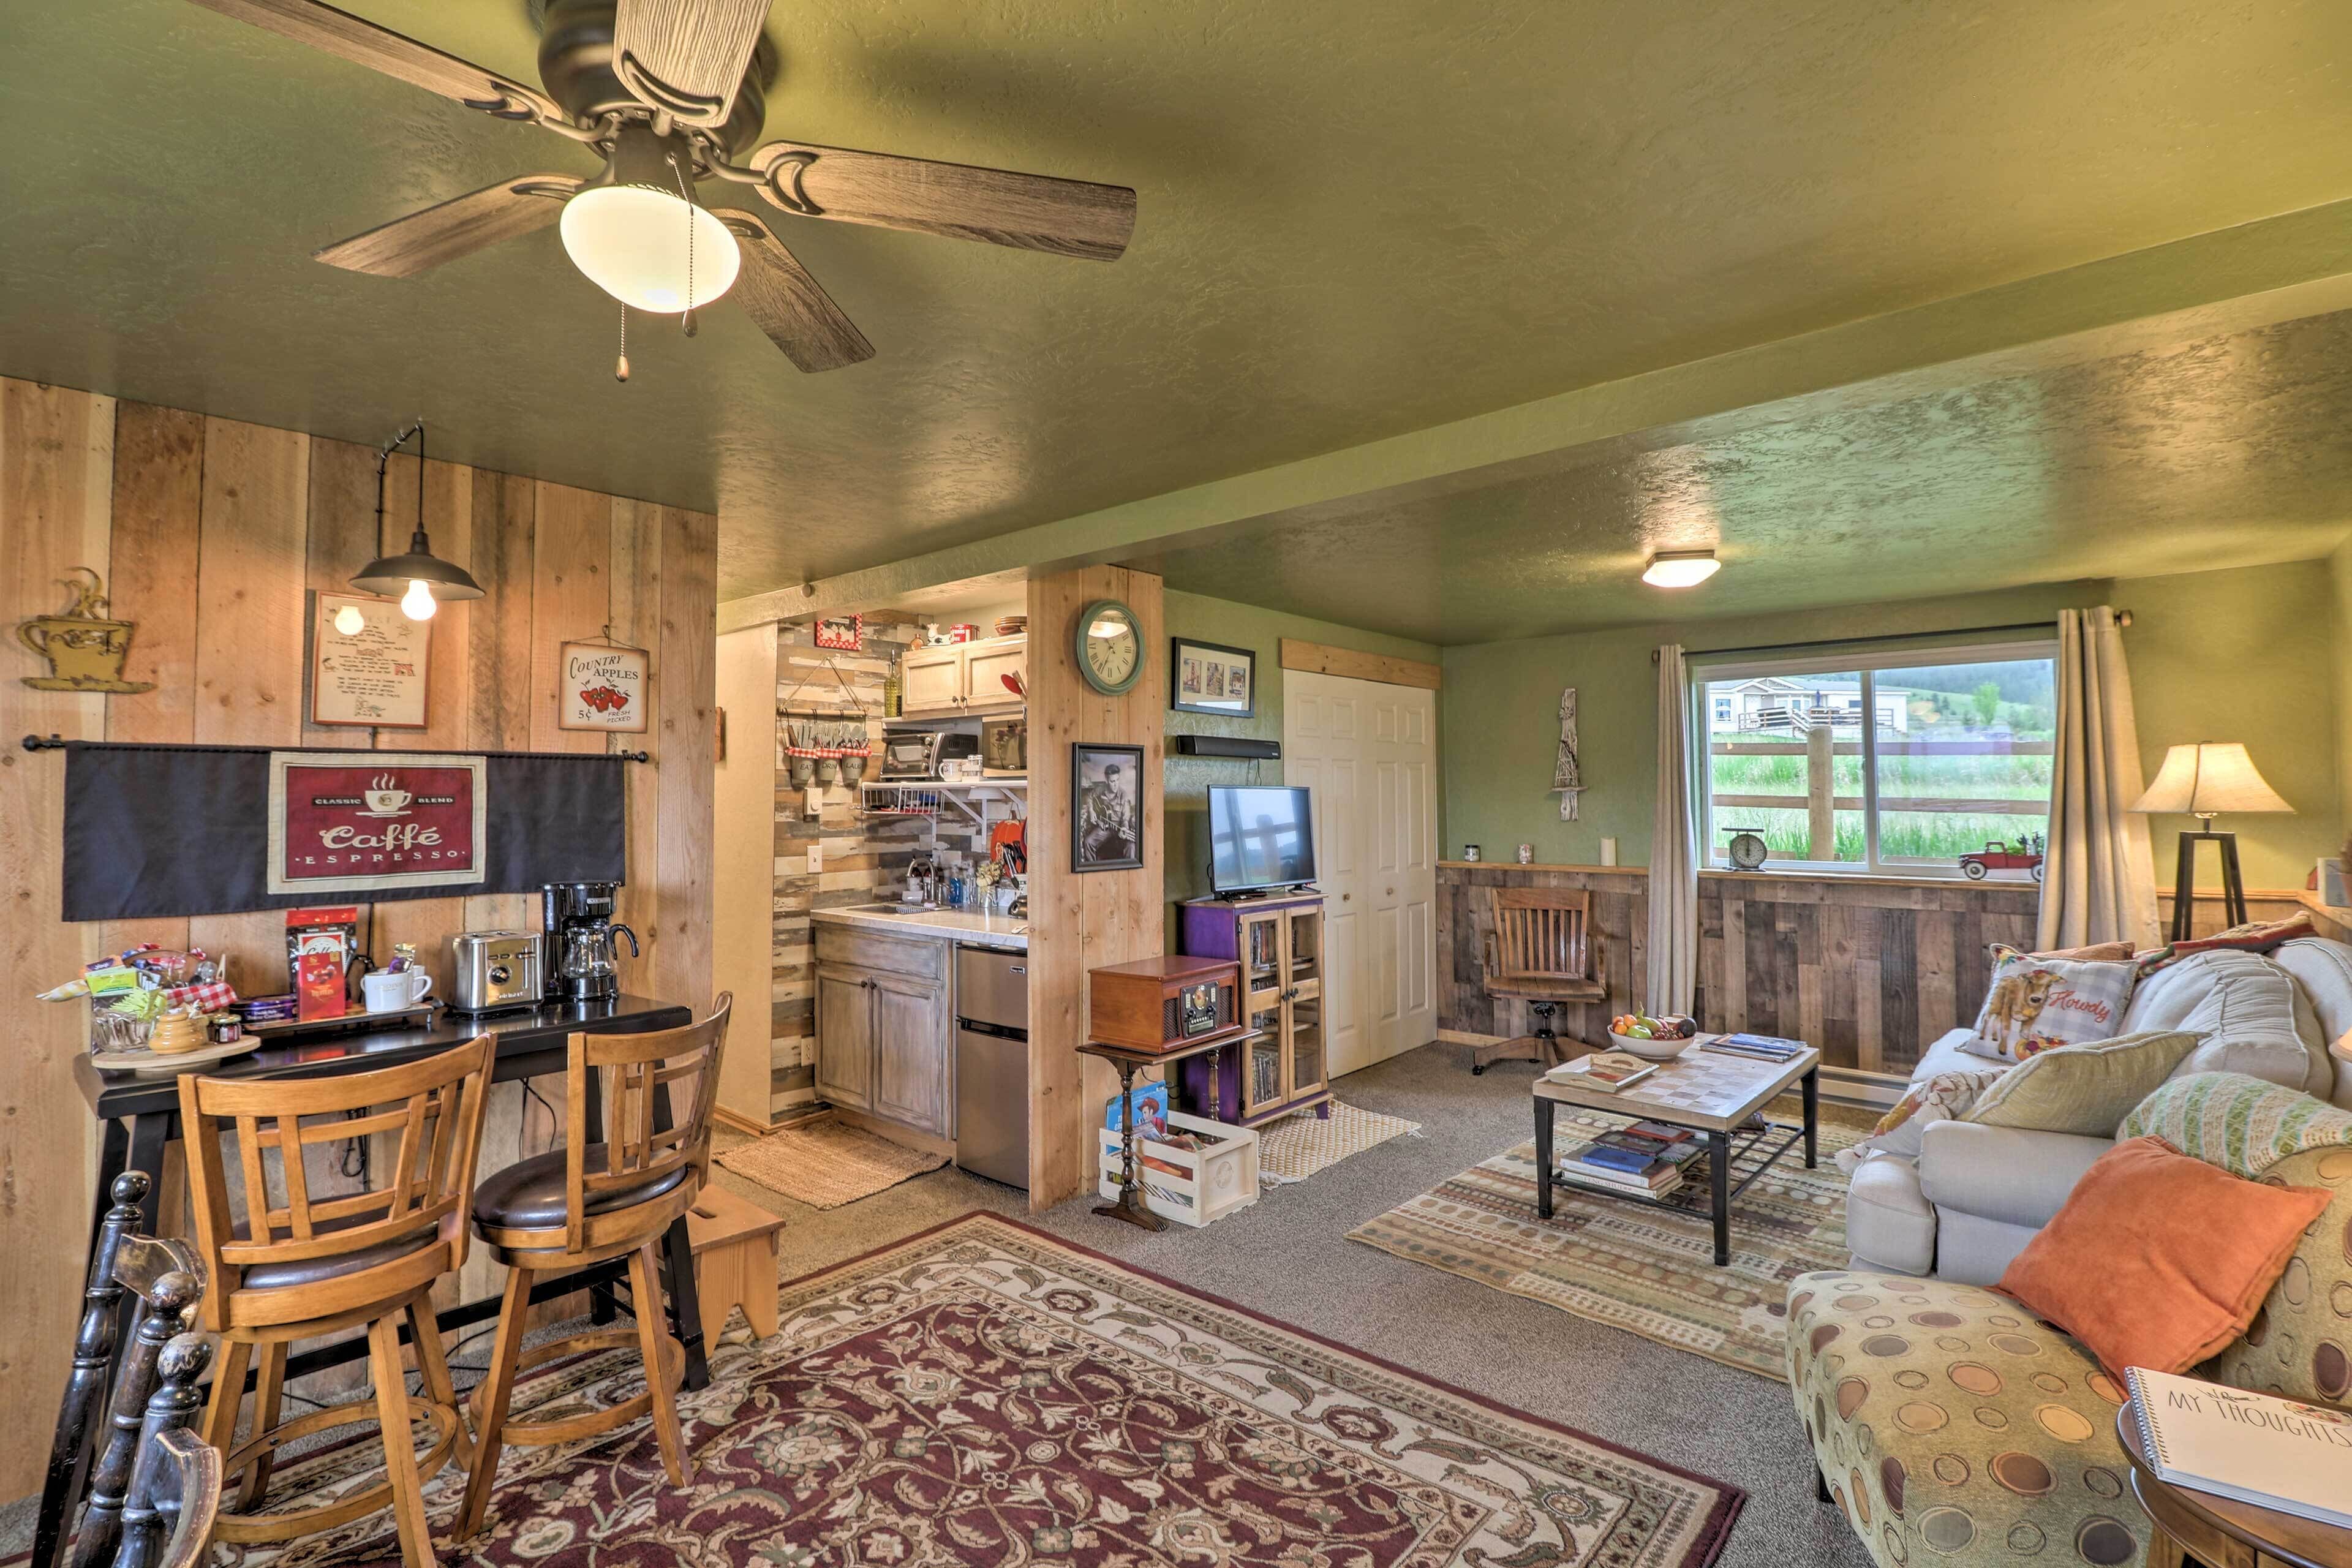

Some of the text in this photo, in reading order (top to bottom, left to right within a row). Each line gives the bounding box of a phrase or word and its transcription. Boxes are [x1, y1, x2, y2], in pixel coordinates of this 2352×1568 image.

[593, 668, 639, 680] APPLES
[2048, 989, 2111, 1023] Howdy
[2169, 1390, 2202, 1414] MY
[2211, 1399, 2352, 1448] THOUGHTS
